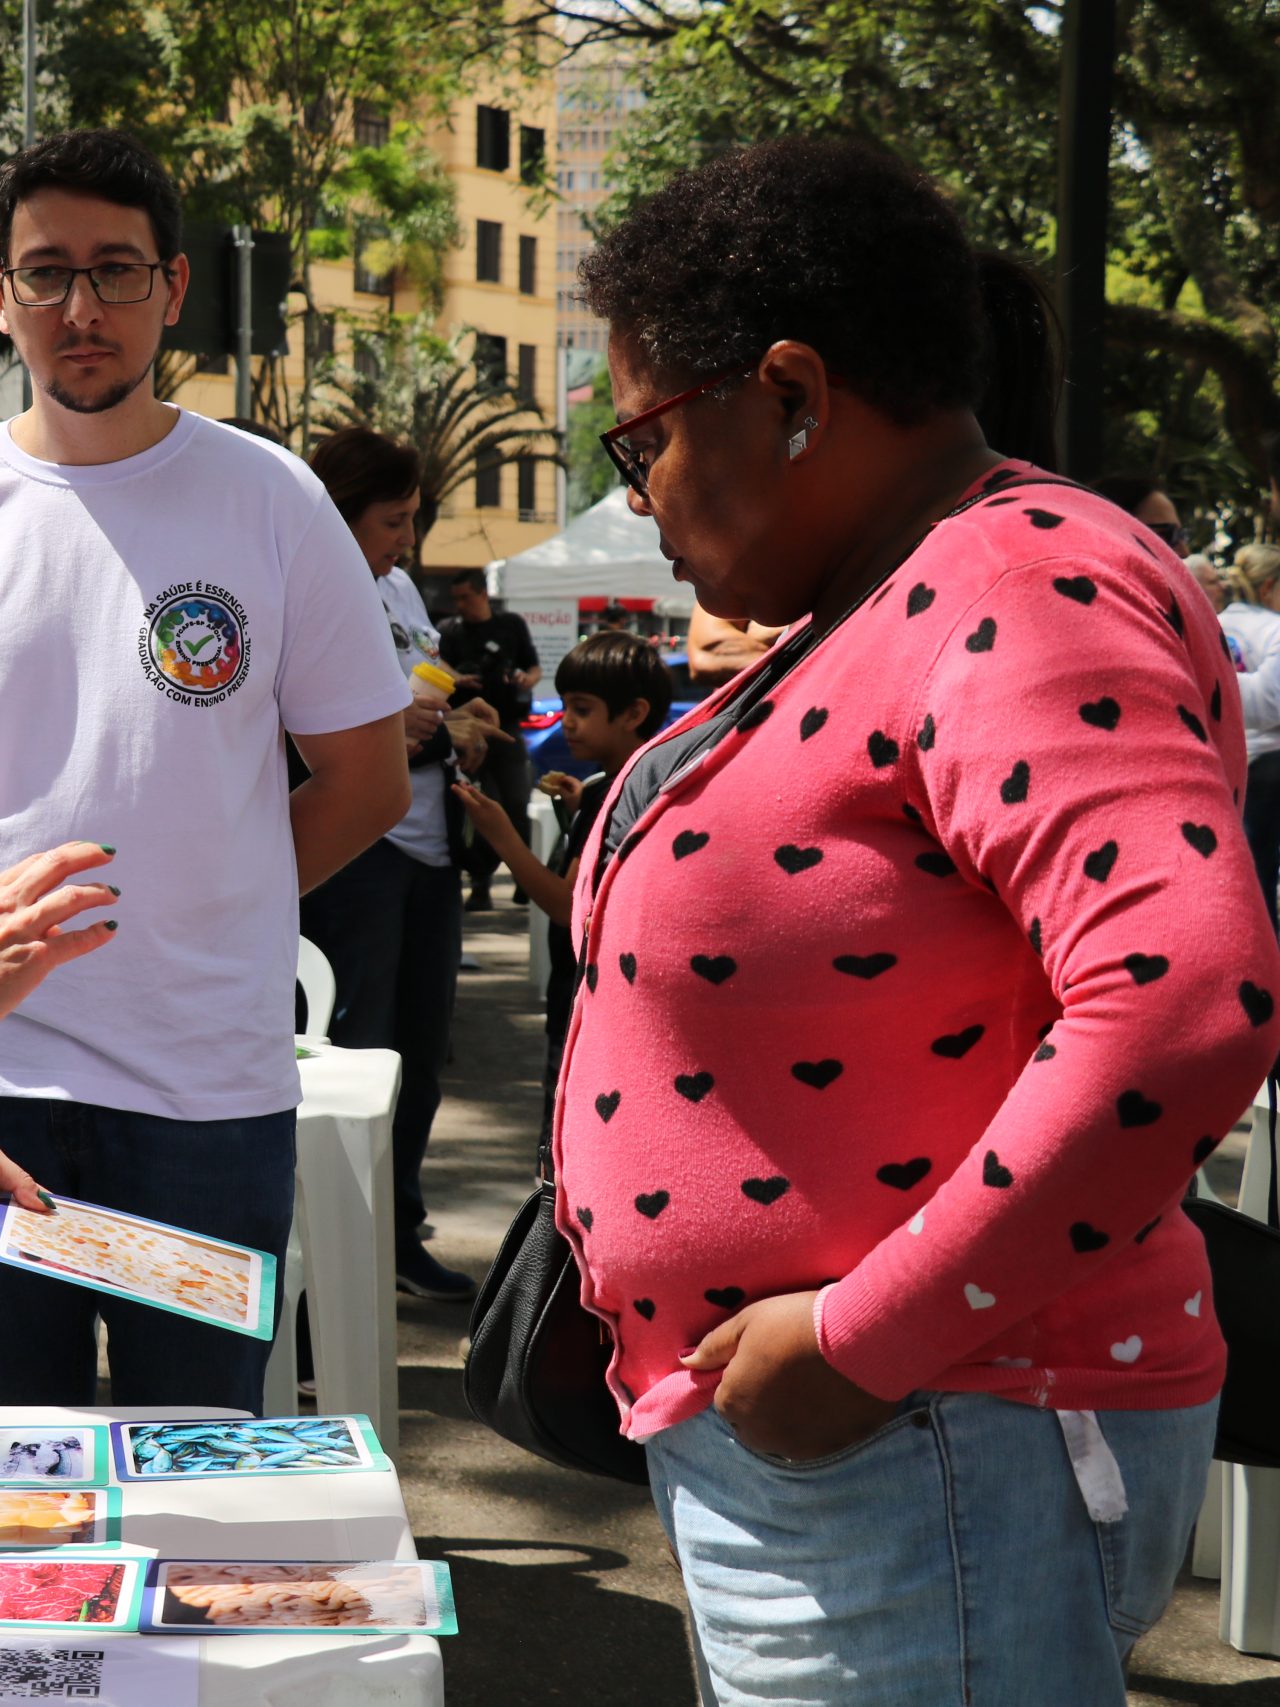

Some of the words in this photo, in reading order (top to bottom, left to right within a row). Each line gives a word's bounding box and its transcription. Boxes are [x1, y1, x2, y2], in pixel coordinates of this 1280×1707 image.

[143, 602, 159, 620] NA
[156, 582, 193, 604] SAÚDE
[195, 580, 203, 592] É
[204, 583, 250, 630] ESSENCIAL
[524, 609, 571, 628] TENÇÃO
[138, 627, 166, 692] GRADUAÇÃO
[166, 688, 192, 706] COM
[194, 692, 226, 708] ENSINO
[226, 637, 252, 697] PRESENCIAL
